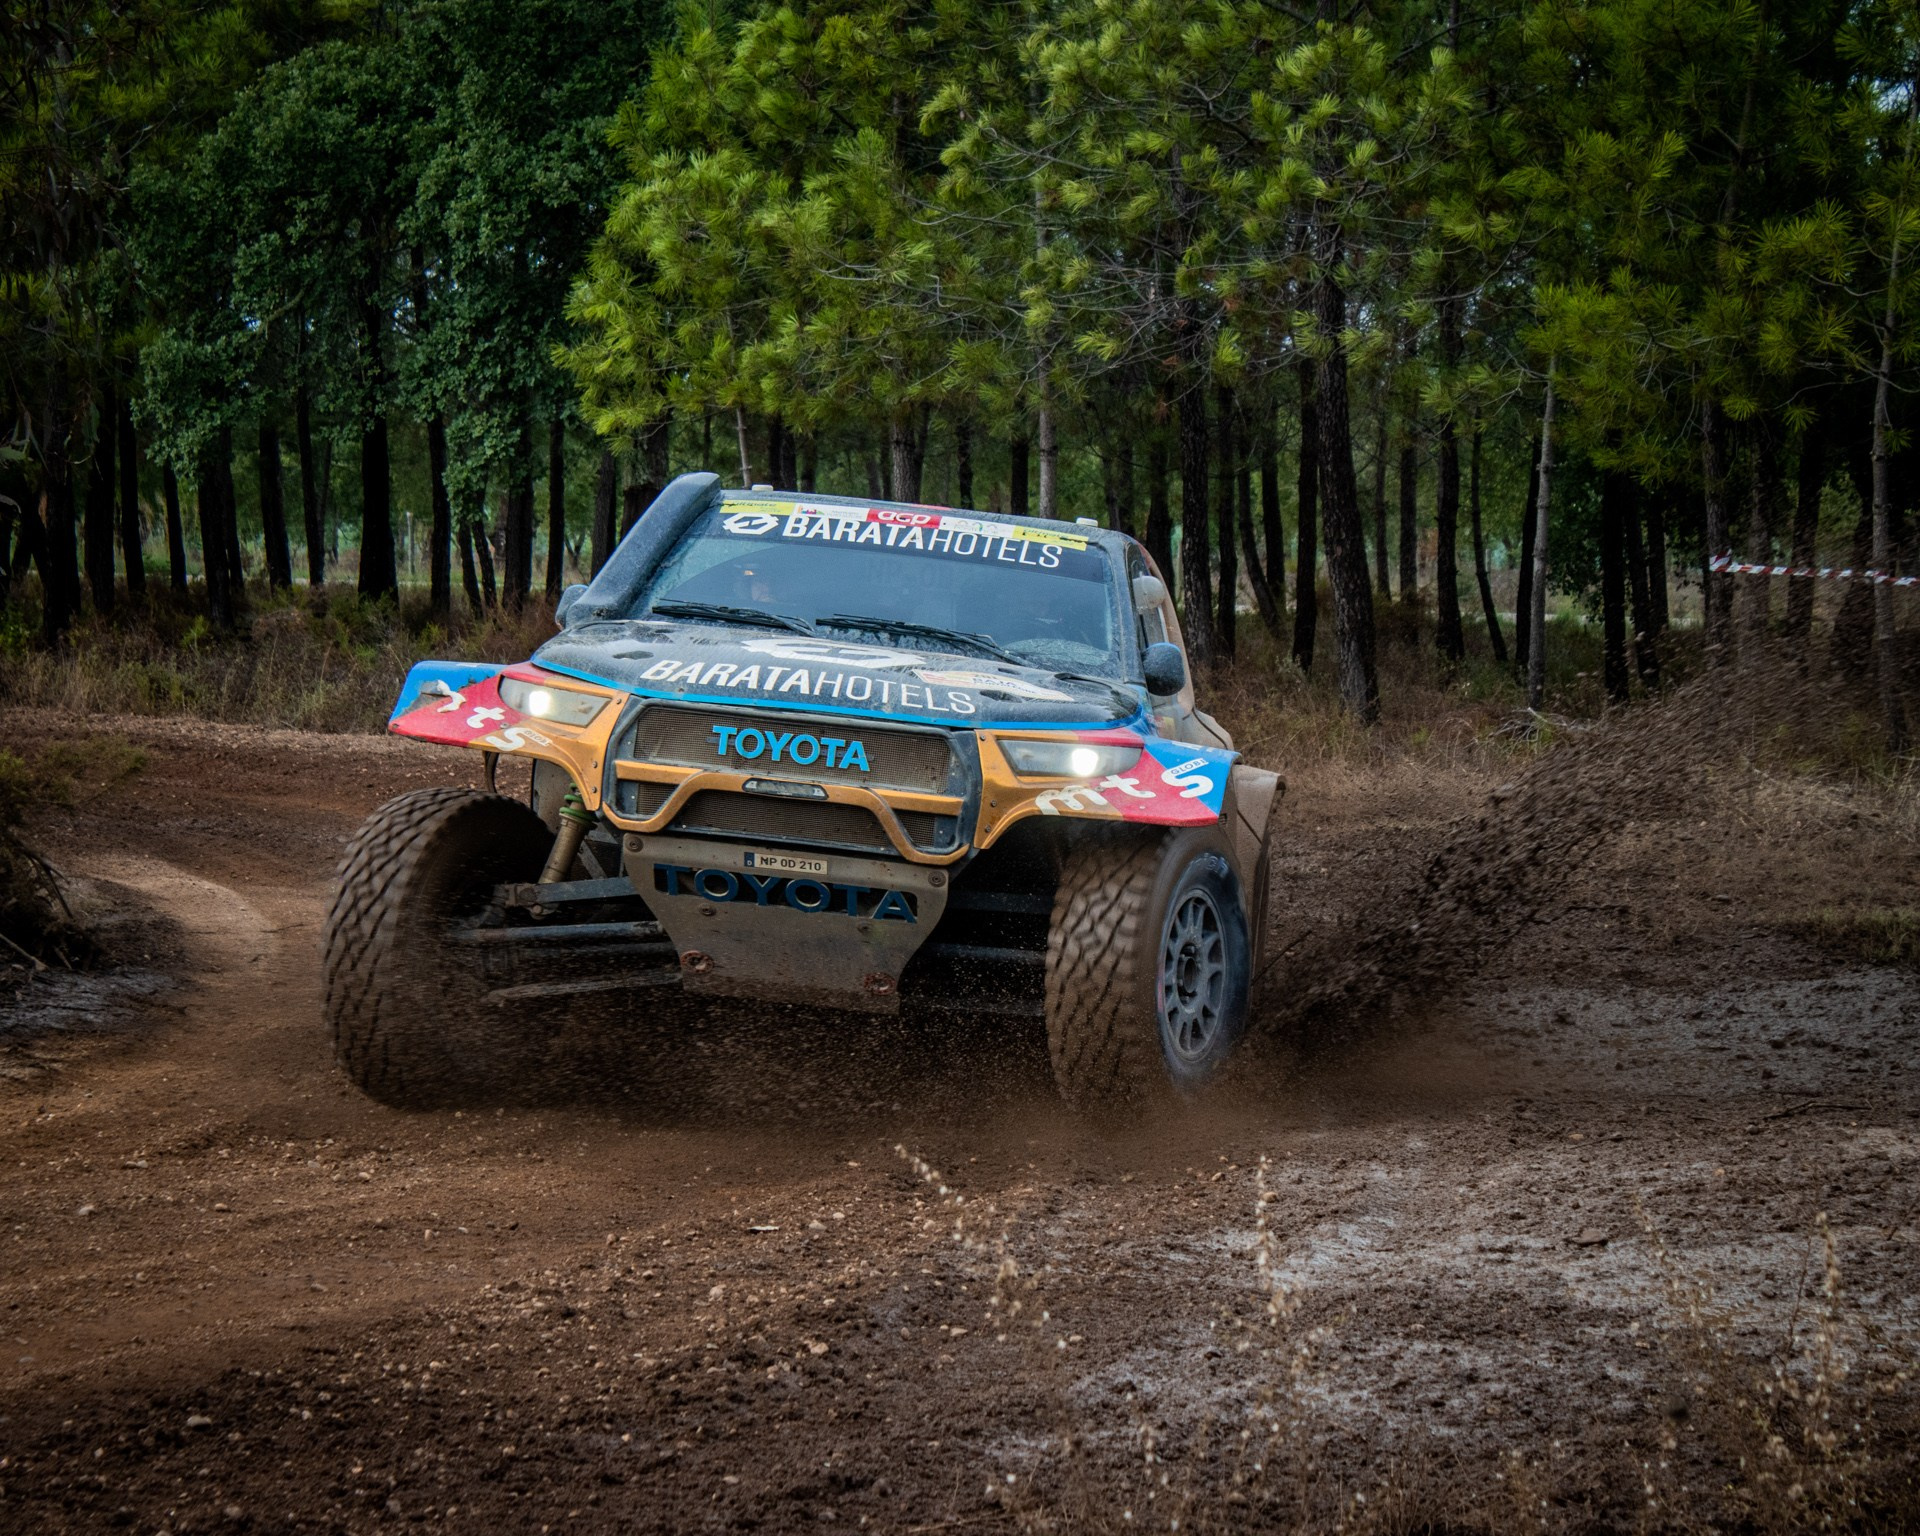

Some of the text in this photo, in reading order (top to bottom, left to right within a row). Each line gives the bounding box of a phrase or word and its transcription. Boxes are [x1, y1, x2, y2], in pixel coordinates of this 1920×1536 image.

[712, 725, 870, 772] TOYOTA
[799, 861, 821, 871] 210
[653, 863, 917, 924] TOYOTA
